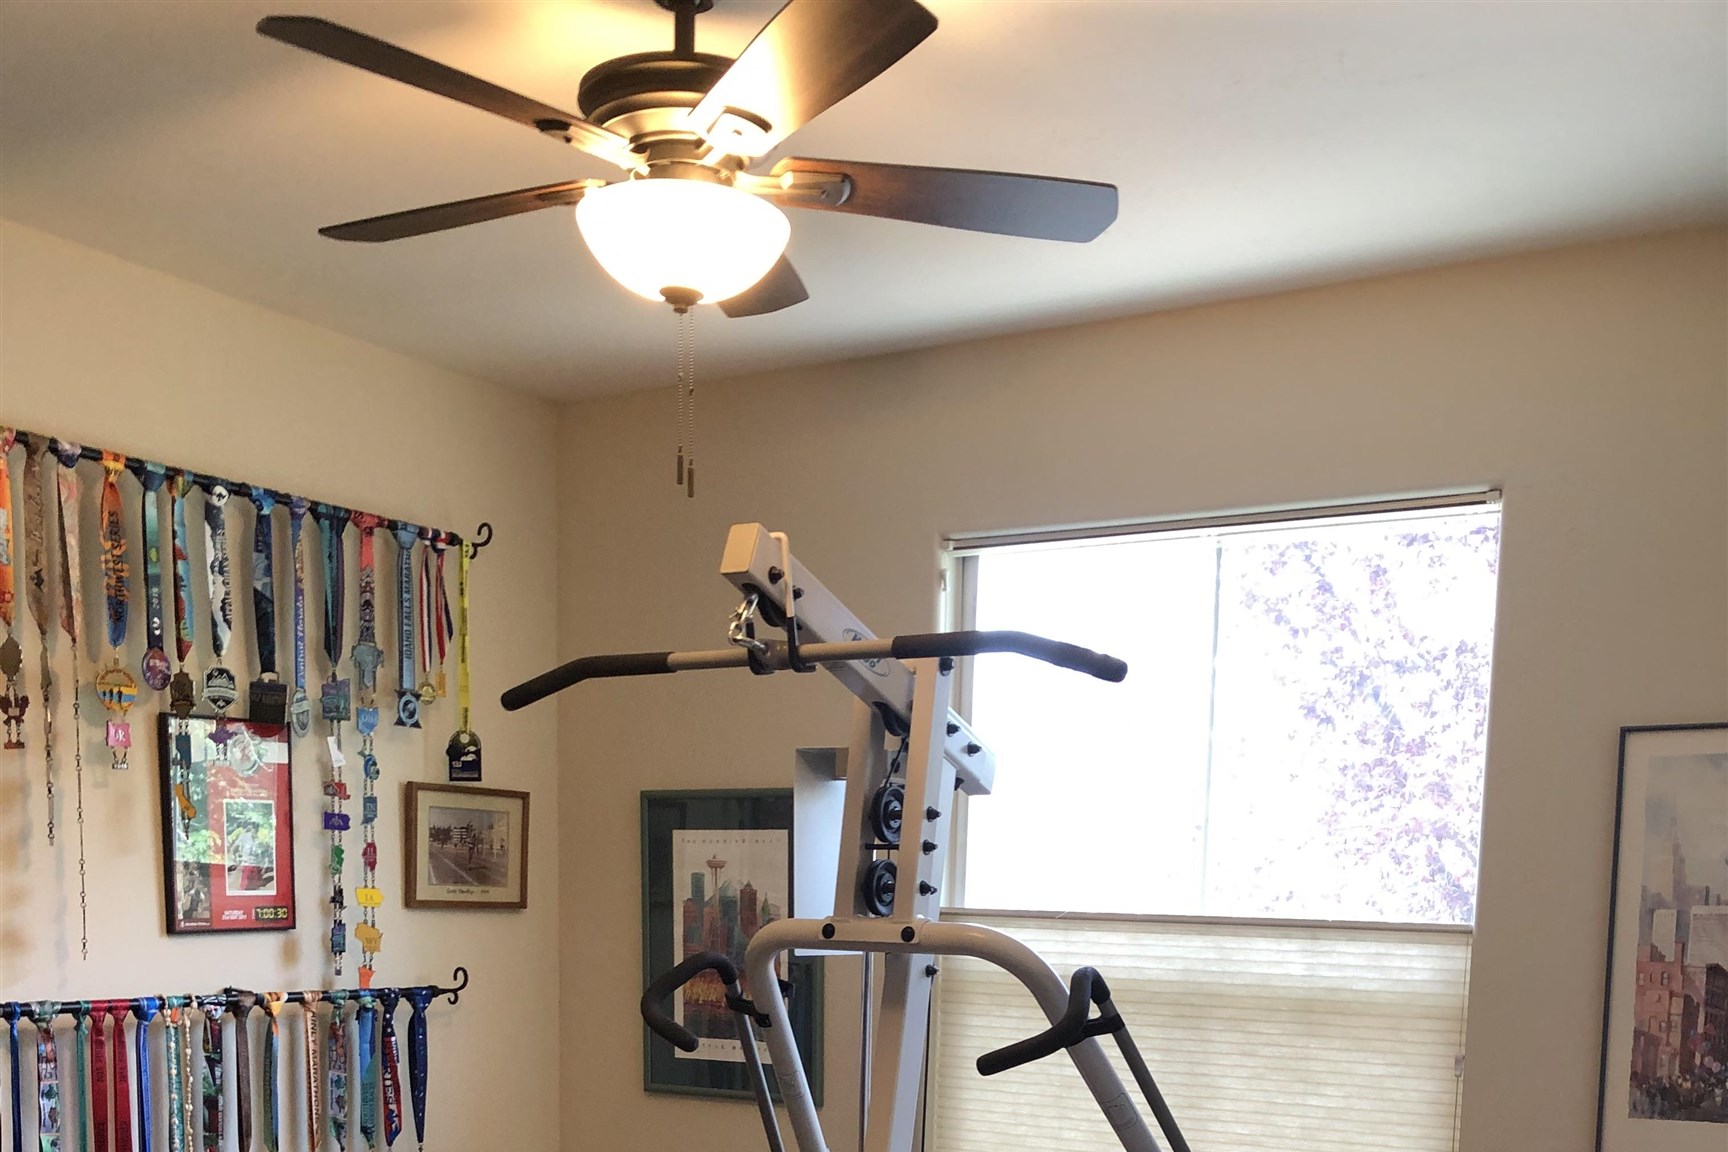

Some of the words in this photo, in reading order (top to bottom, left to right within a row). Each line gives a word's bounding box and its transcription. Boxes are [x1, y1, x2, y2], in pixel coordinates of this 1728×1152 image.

[108, 510, 122, 551] SERIES
[404, 597, 412, 627] FALLS
[404, 629, 412, 660] IDAHO
[312, 1049, 320, 1122] MARATHONS
